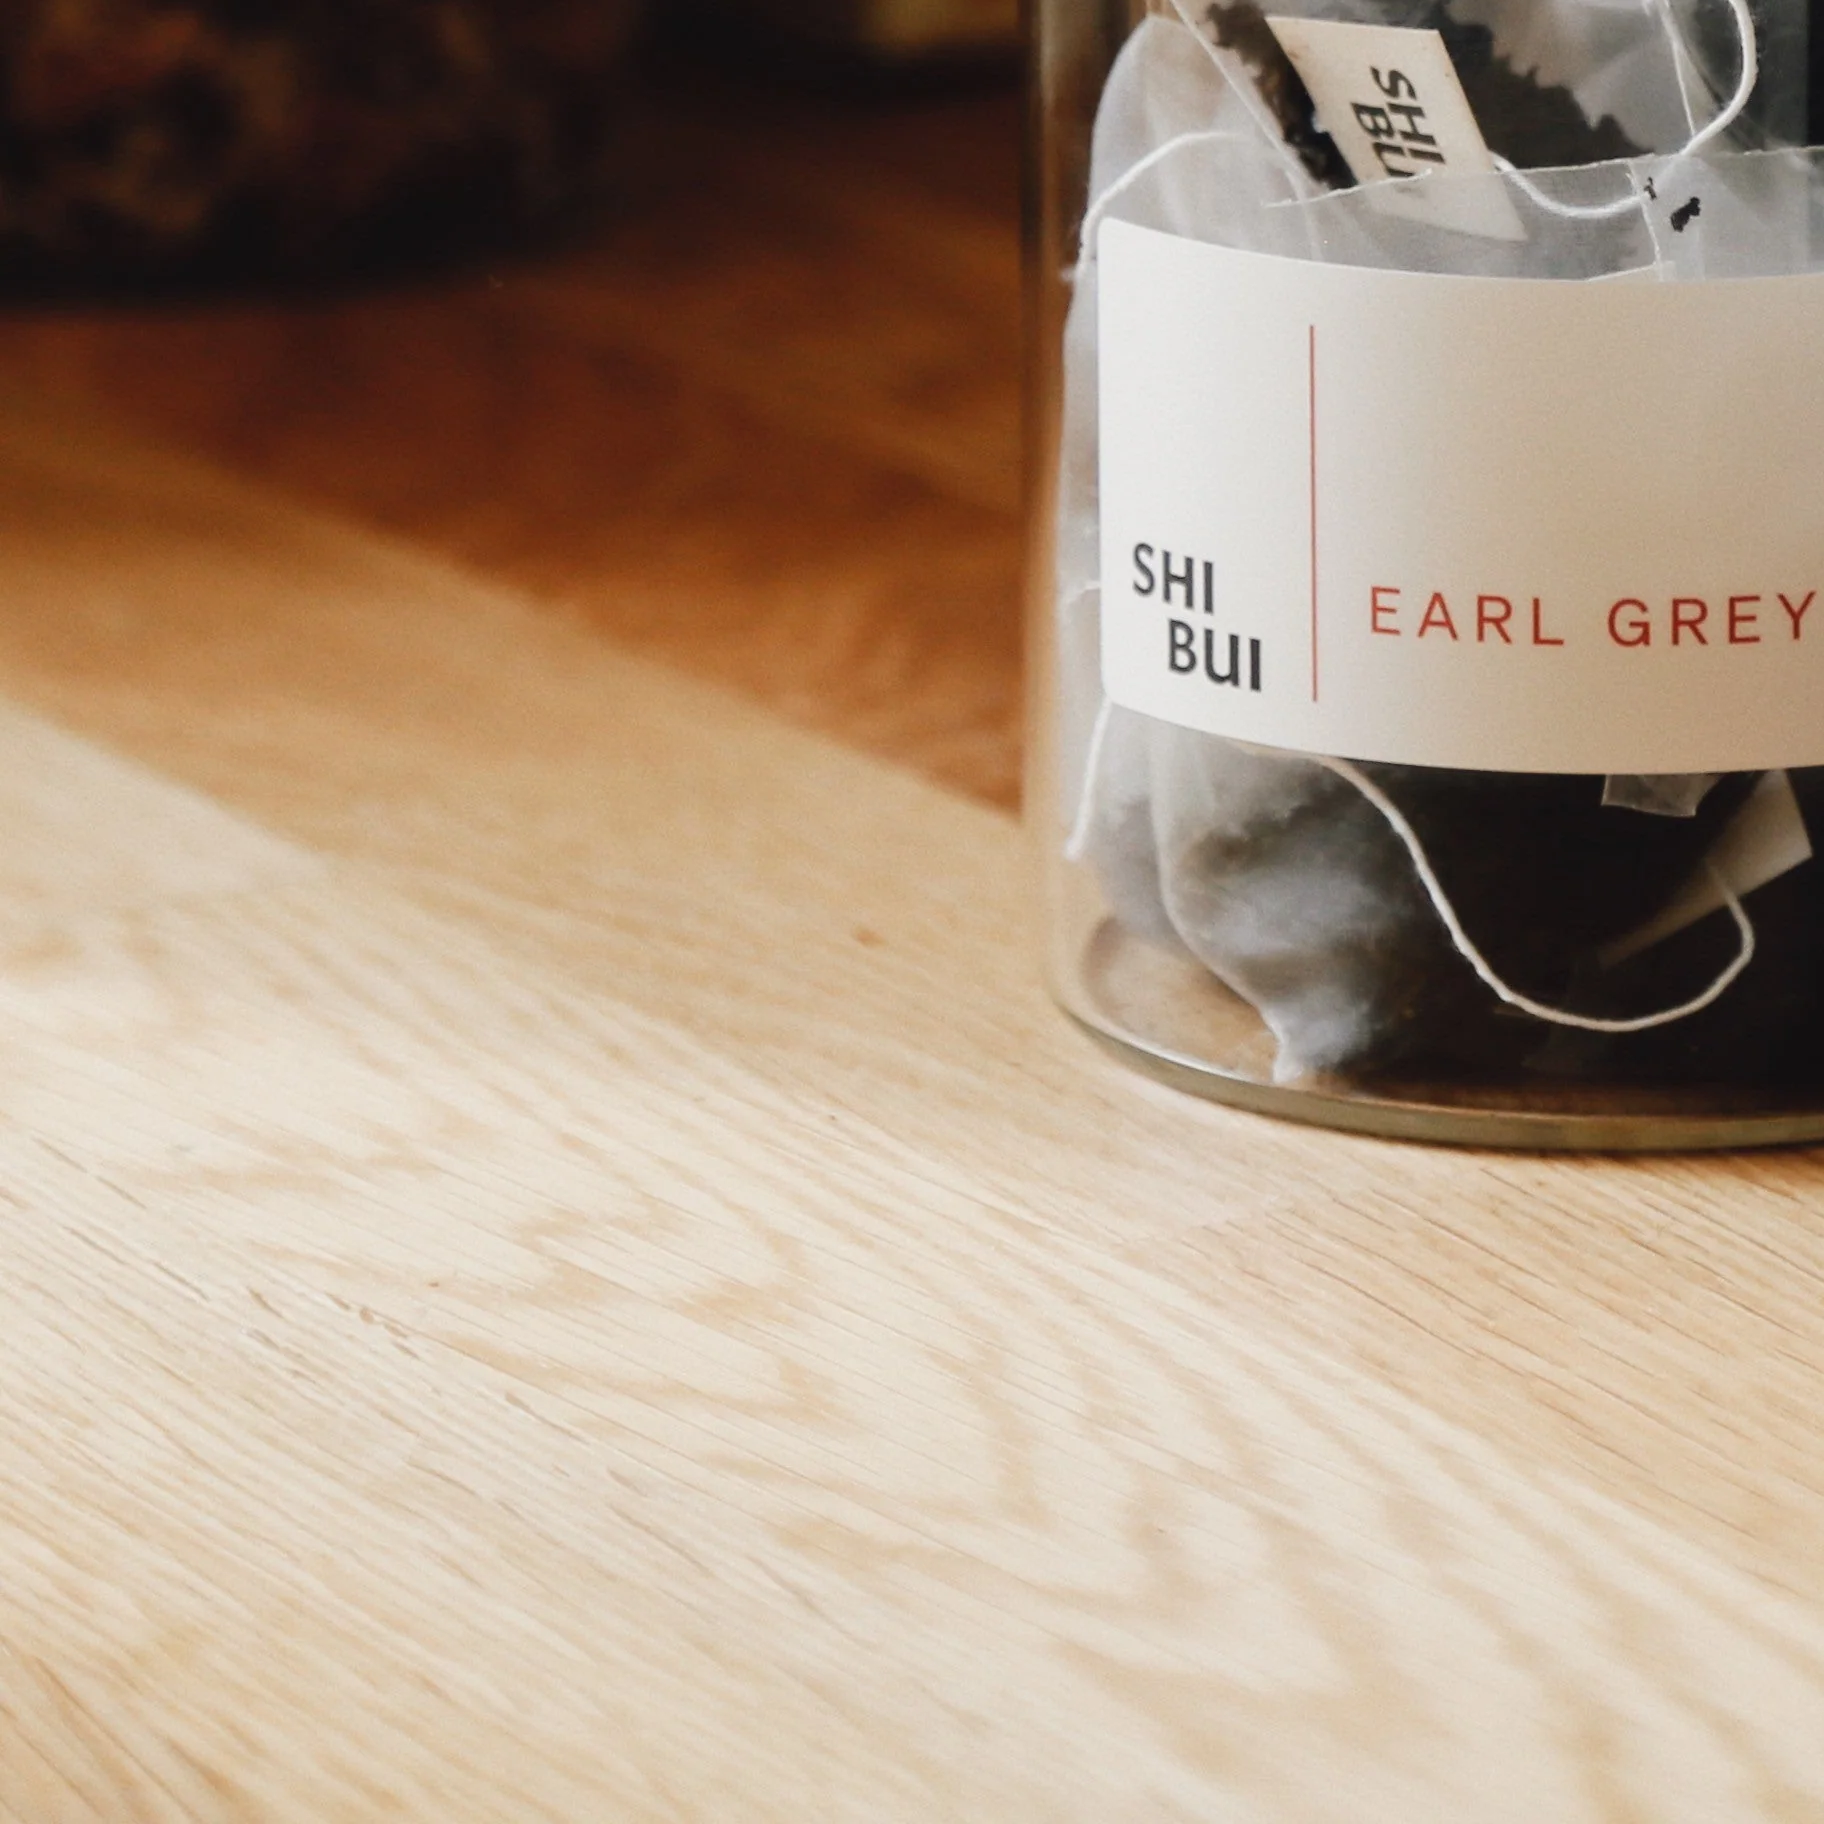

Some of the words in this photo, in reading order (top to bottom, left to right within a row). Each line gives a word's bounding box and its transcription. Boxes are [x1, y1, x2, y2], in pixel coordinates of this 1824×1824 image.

[1351, 102, 1422, 188] BU
[1369, 65, 1446, 165] SHI
[1132, 543, 1214, 614] SHI
[1370, 585, 1566, 647] EARL
[1606, 590, 1817, 649] GREY
[1169, 619, 1261, 691] BUI
